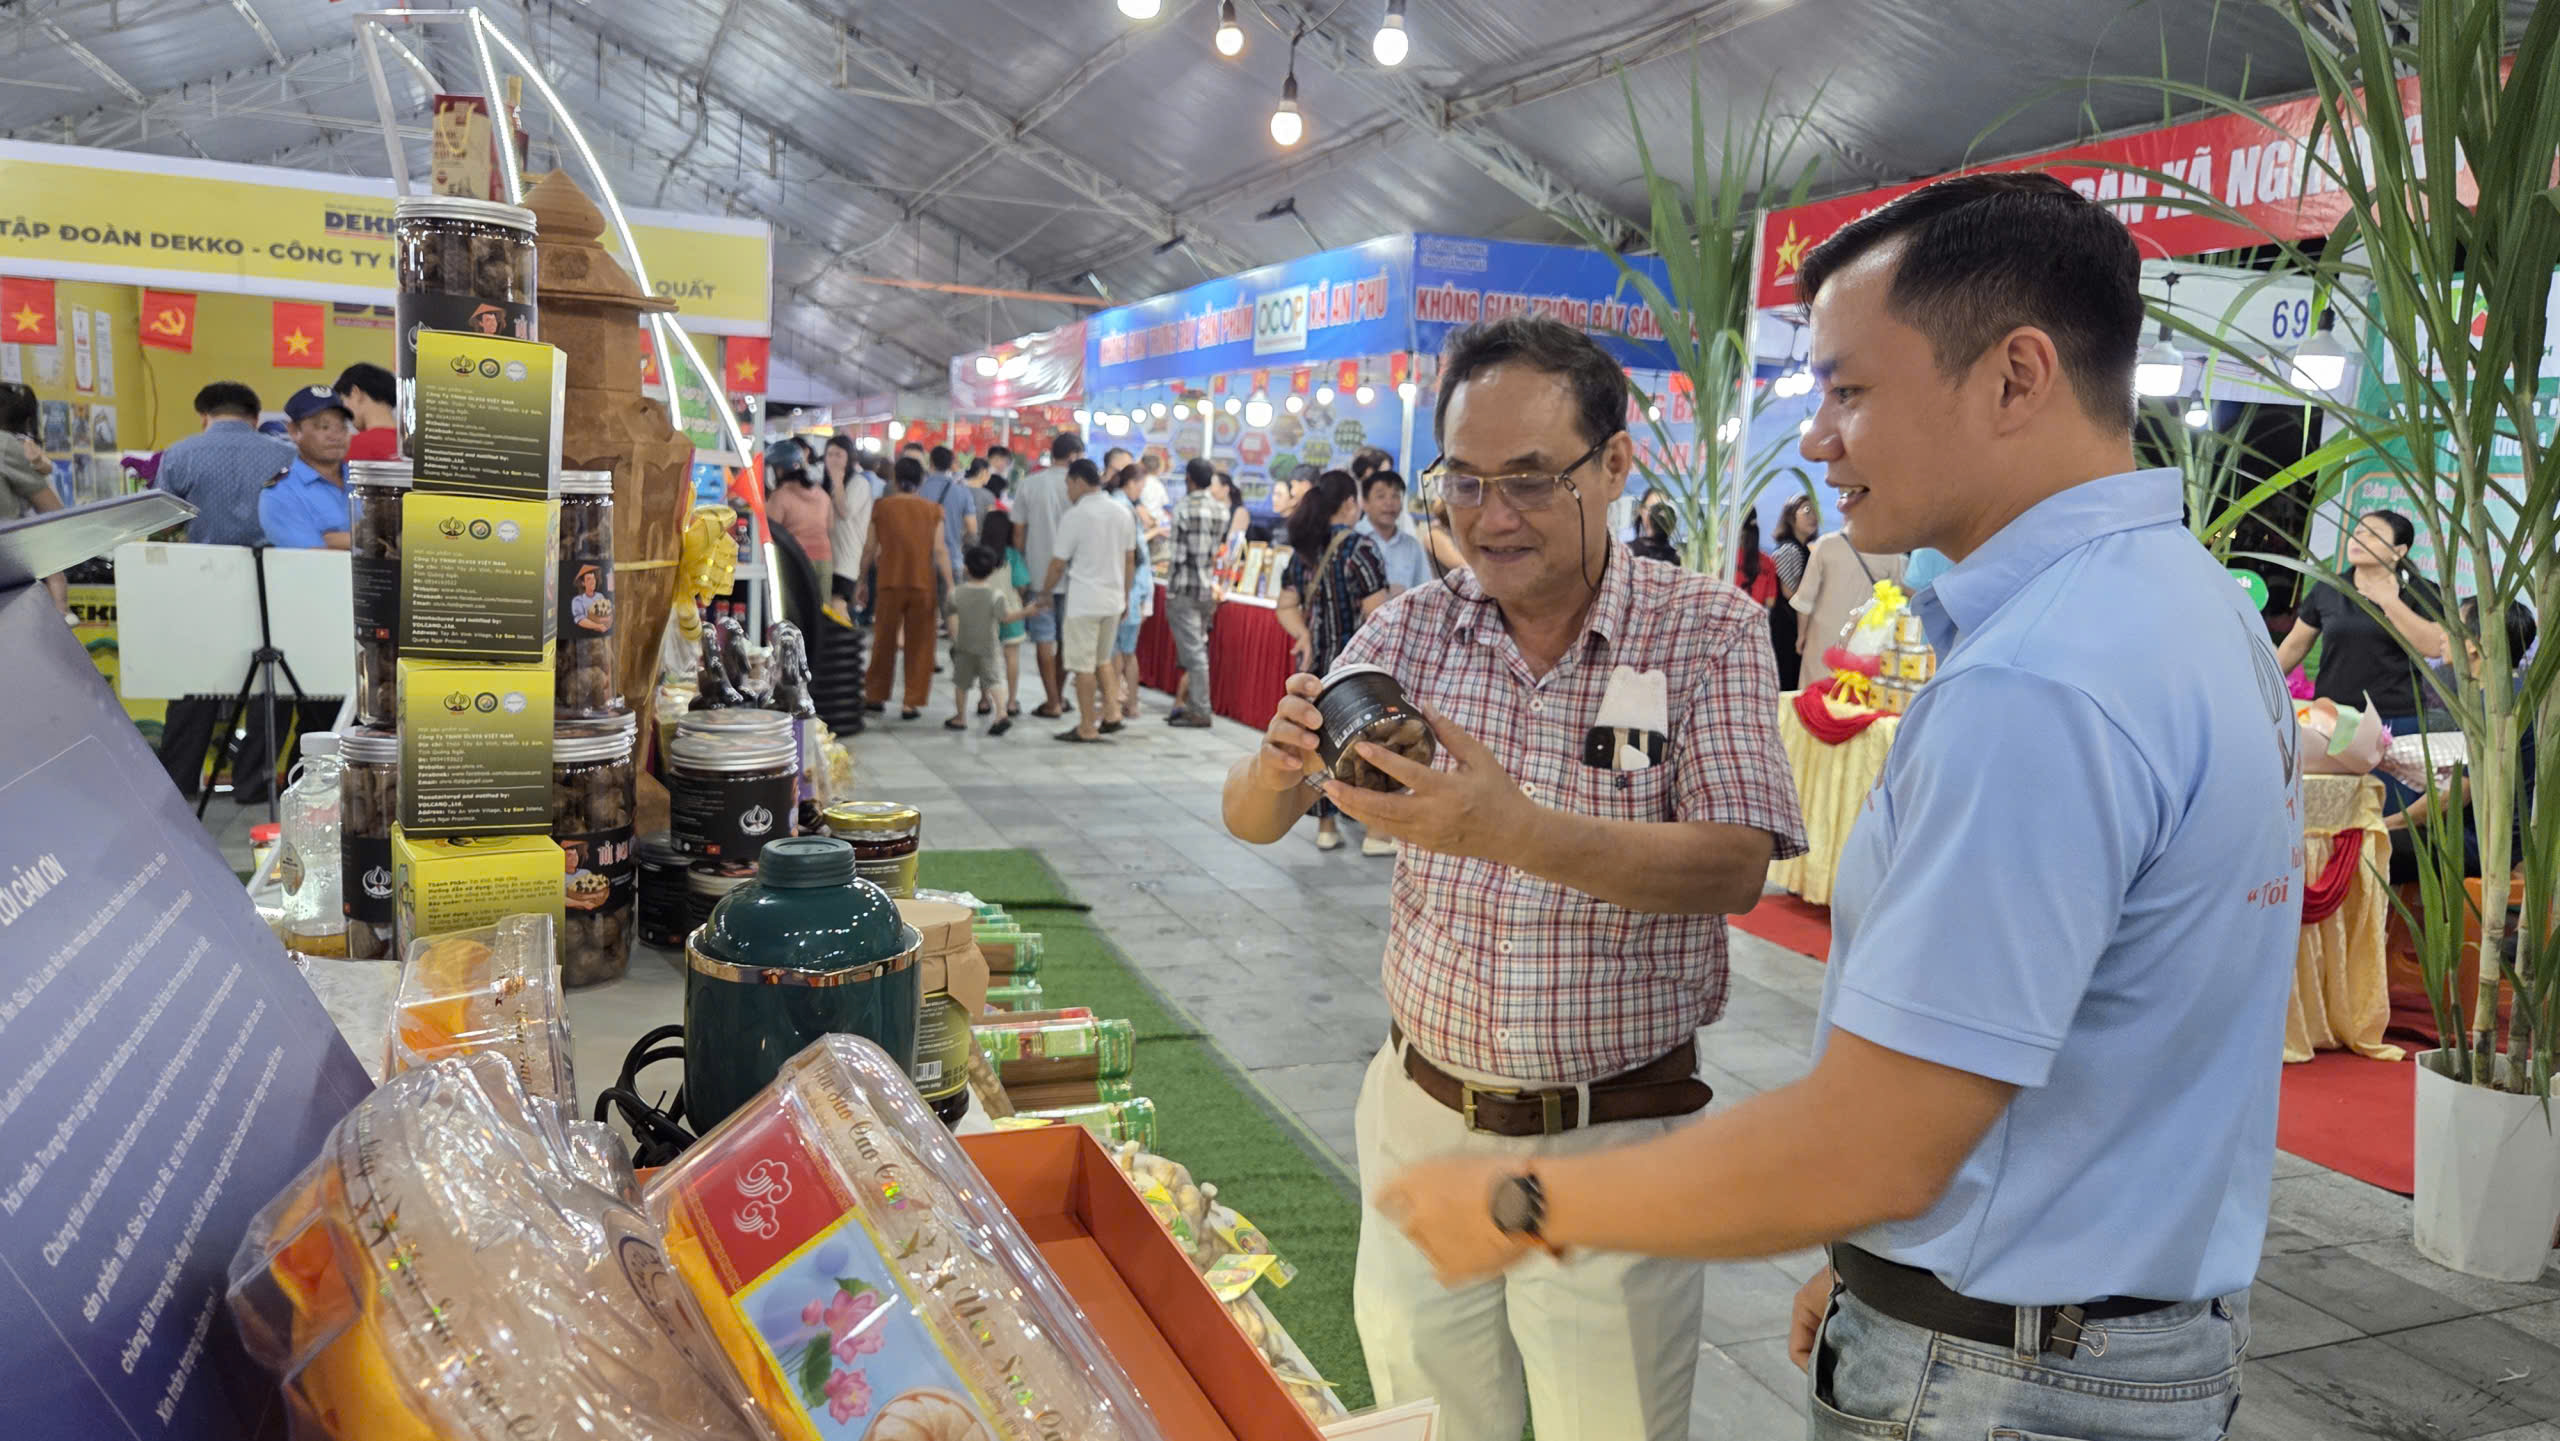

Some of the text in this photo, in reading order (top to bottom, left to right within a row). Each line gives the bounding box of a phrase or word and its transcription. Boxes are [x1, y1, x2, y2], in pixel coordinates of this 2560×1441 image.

[2154, 144, 2214, 220] XÃ
[59, 221, 142, 247] ĐOÀN
[149, 232, 244, 256] DEKKO
[269, 239, 344, 266] CÔNG
[350, 249, 381, 269] TY
[1256, 294, 1305, 336] OCOP
[1329, 282, 1355, 327] AN
[1354, 264, 1389, 322] PHÚ
[1415, 280, 1480, 323] KHÔNG
[2272, 298, 2310, 340] 69
